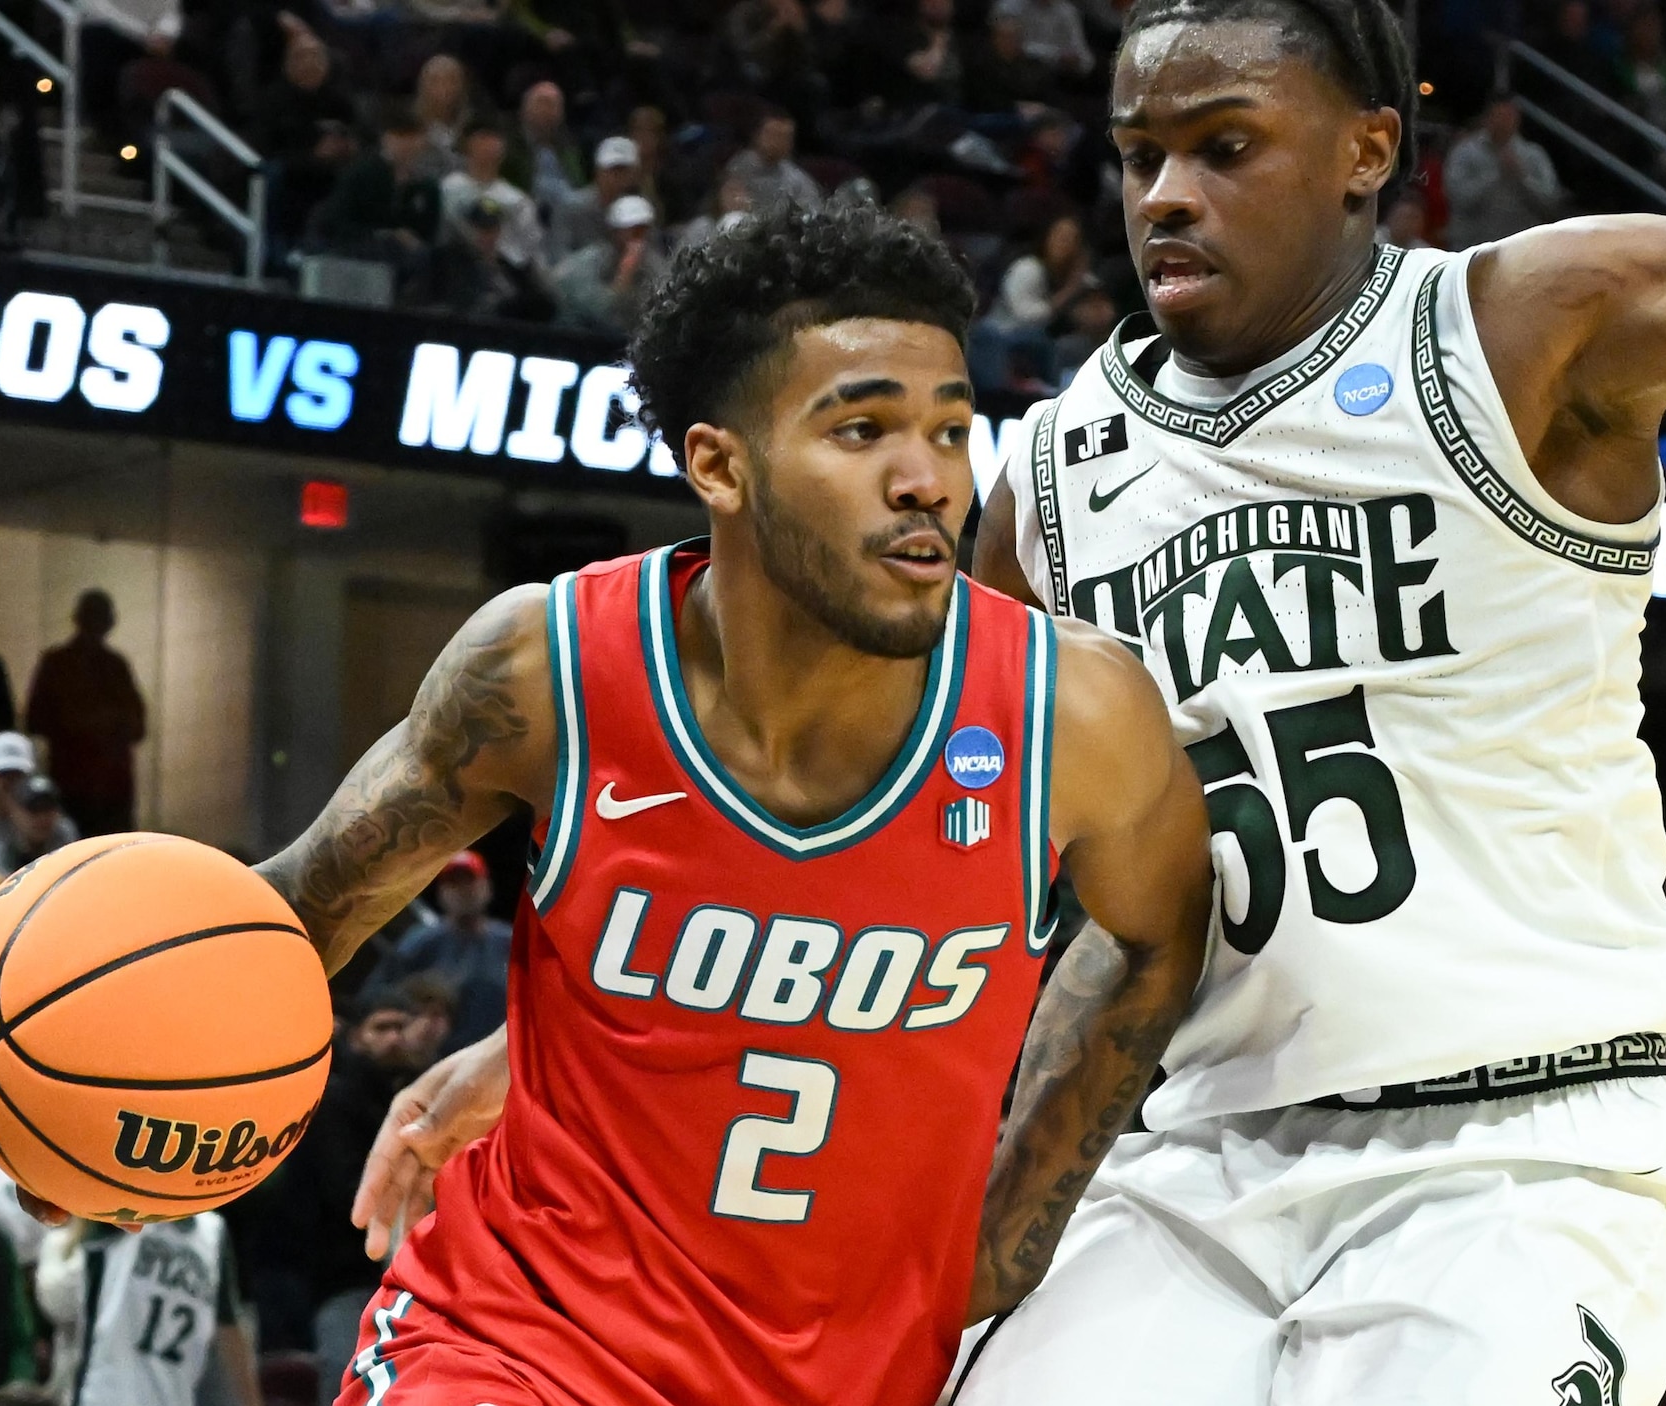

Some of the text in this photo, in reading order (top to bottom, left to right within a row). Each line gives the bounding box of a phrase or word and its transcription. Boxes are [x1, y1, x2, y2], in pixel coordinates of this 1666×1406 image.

[229, 330, 360, 432] VS
[1343, 382, 1390, 405] NCAA
[1077, 419, 1113, 462] JF
[1142, 502, 1354, 602] MICHIGAN
[952, 754, 1002, 774] NCAA
[1184, 684, 1417, 956] 55
[590, 886, 1012, 1033] LOBOS
[710, 1049, 842, 1224] 2
[137, 1293, 197, 1365] 12
